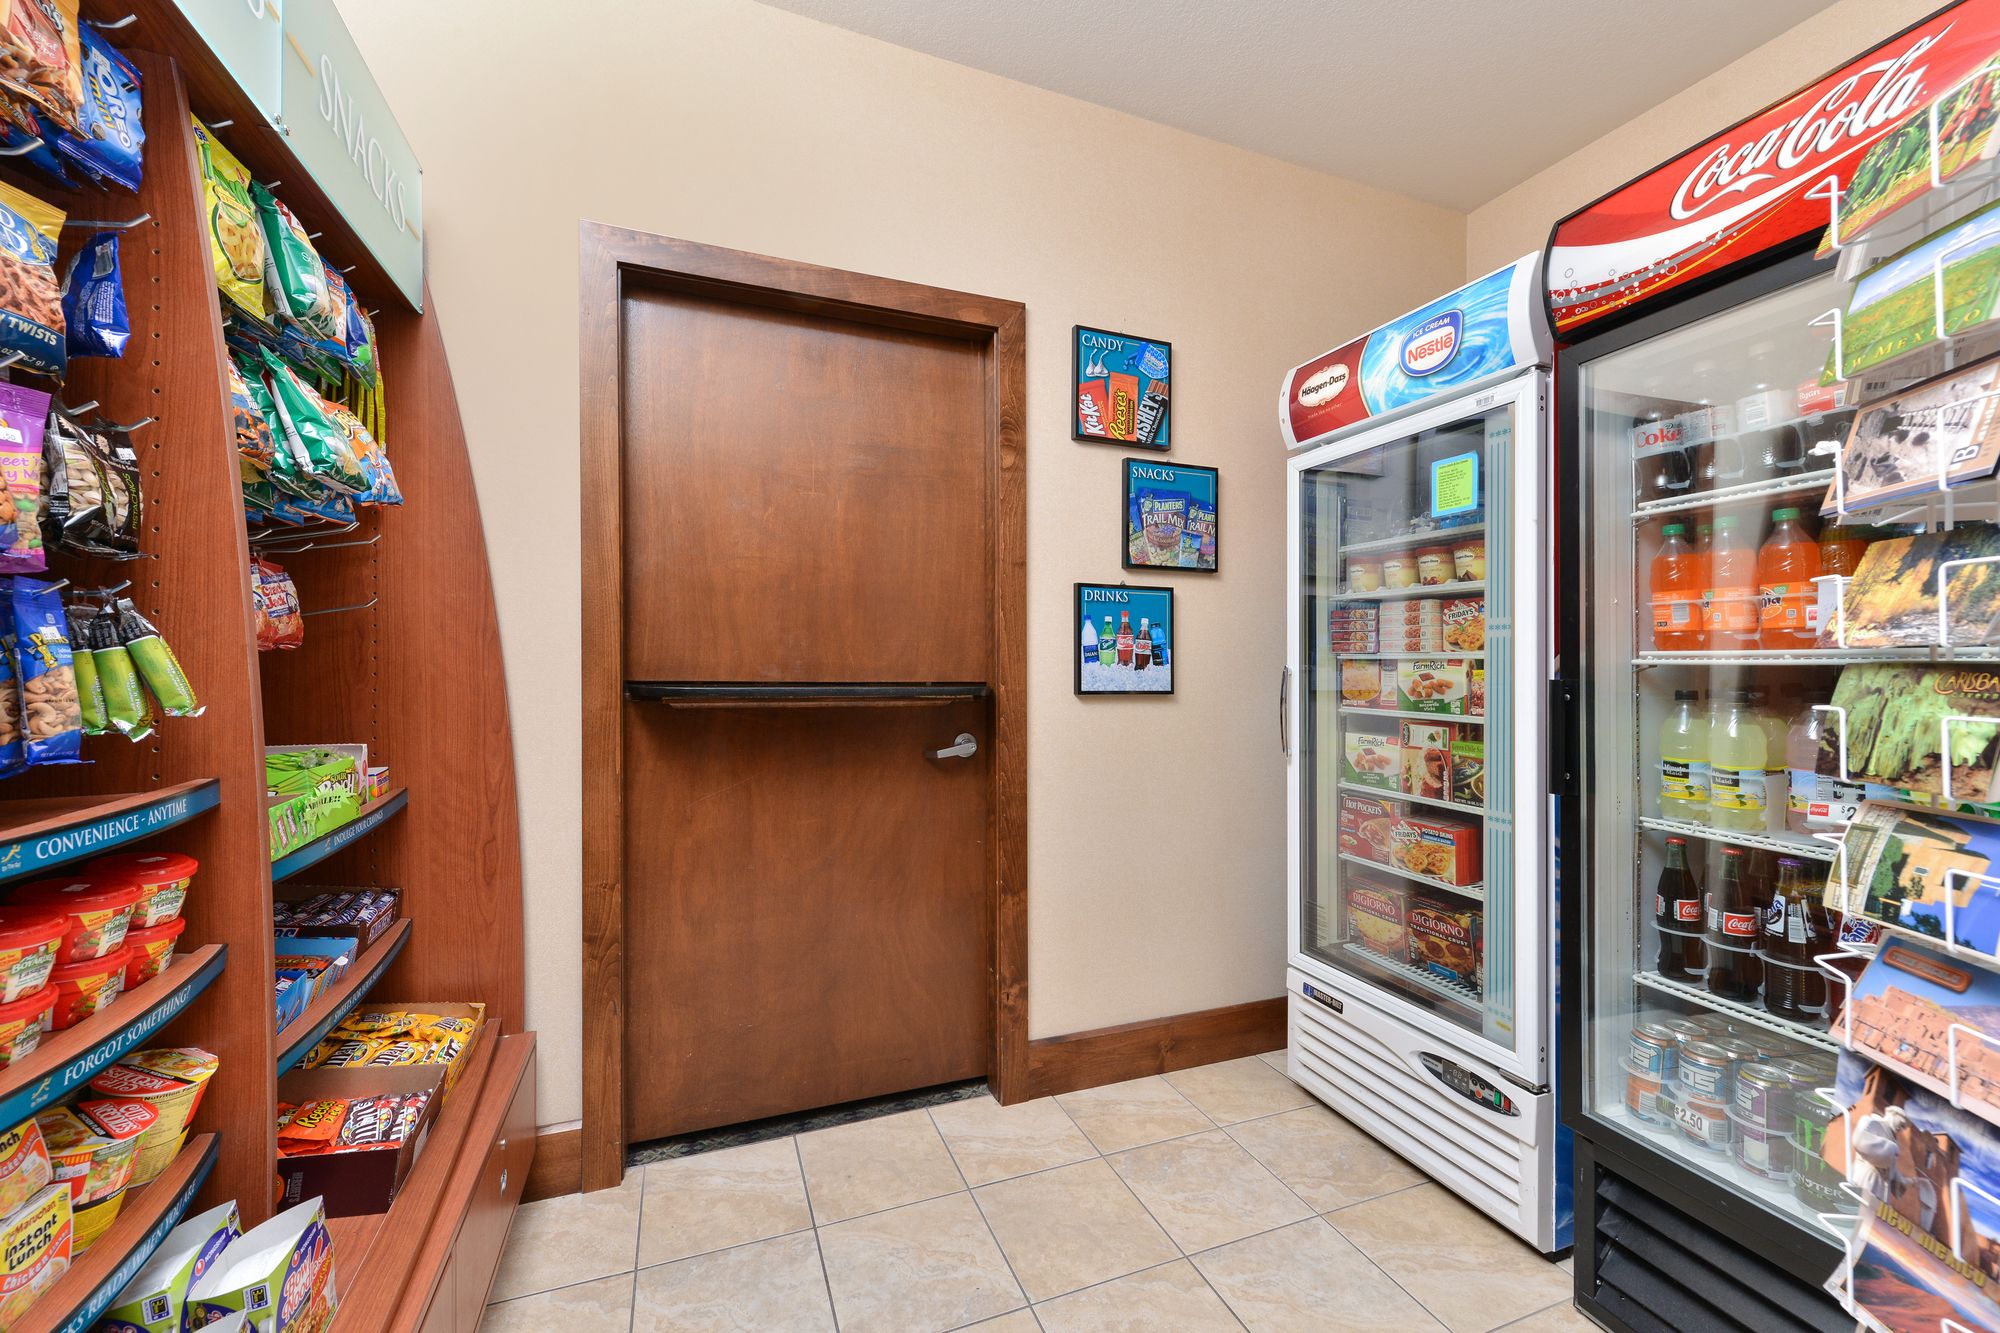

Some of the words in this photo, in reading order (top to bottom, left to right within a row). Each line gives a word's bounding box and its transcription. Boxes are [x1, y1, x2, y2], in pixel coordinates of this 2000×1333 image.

[98, 66, 131, 149] OREO
[1669, 19, 1959, 220] Coca-Cola
[319, 54, 406, 233] SNACKS
[9, 316, 57, 346] TWISTS
[1413, 328, 1424, 339] ICE
[1425, 316, 1451, 333] CREAM
[1082, 334, 1124, 352] CANDY
[1301, 372, 1347, 399] Häagen-Dazs
[1636, 426, 1683, 449] Coke
[1132, 466, 1174, 481] SNACKS
[122, 472, 140, 529] PISTACHIOS
[1154, 501, 1183, 511] PLANTERS
[1142, 513, 1167, 527] TRAIL
[1168, 514, 1185, 528] MIX
[1084, 590, 1129, 602] DRINKS
[1448, 608, 1474, 621] FRIDAYS
[330, 772, 347, 785] SOUR
[1345, 799, 1356, 809] HOT
[1356, 802, 1382, 815] POCKETS
[35, 815, 139, 859] CONVENIENCE
[147, 798, 188, 826] ANYTIME
[333, 826, 356, 846] INDULGE
[1351, 903, 1380, 918] TRADITIONAL
[1381, 913, 1399, 924] CRUST
[1412, 912, 1464, 938] DIGIORNO
[1410, 922, 1447, 941] TRADITIONAL
[1448, 935, 1468, 947] CRUST
[63, 1033, 125, 1086] FORGOT
[125, 984, 192, 1047] SOMETHING?
[144, 1088, 180, 1101] Nutrition
[90, 1103, 140, 1134] NOODLES
[119, 1103, 153, 1122] CUP
[1674, 1103, 1704, 1133] $2.50
[15, 1200, 57, 1234] Maruchan
[1876, 1200, 1913, 1237] NEW
[5, 1213, 58, 1262] Instant
[8, 1233, 52, 1272] Lunch
[3, 1253, 50, 1291] Chicken
[88, 1271, 134, 1312] READY
[132, 1229, 164, 1270] WHEN
